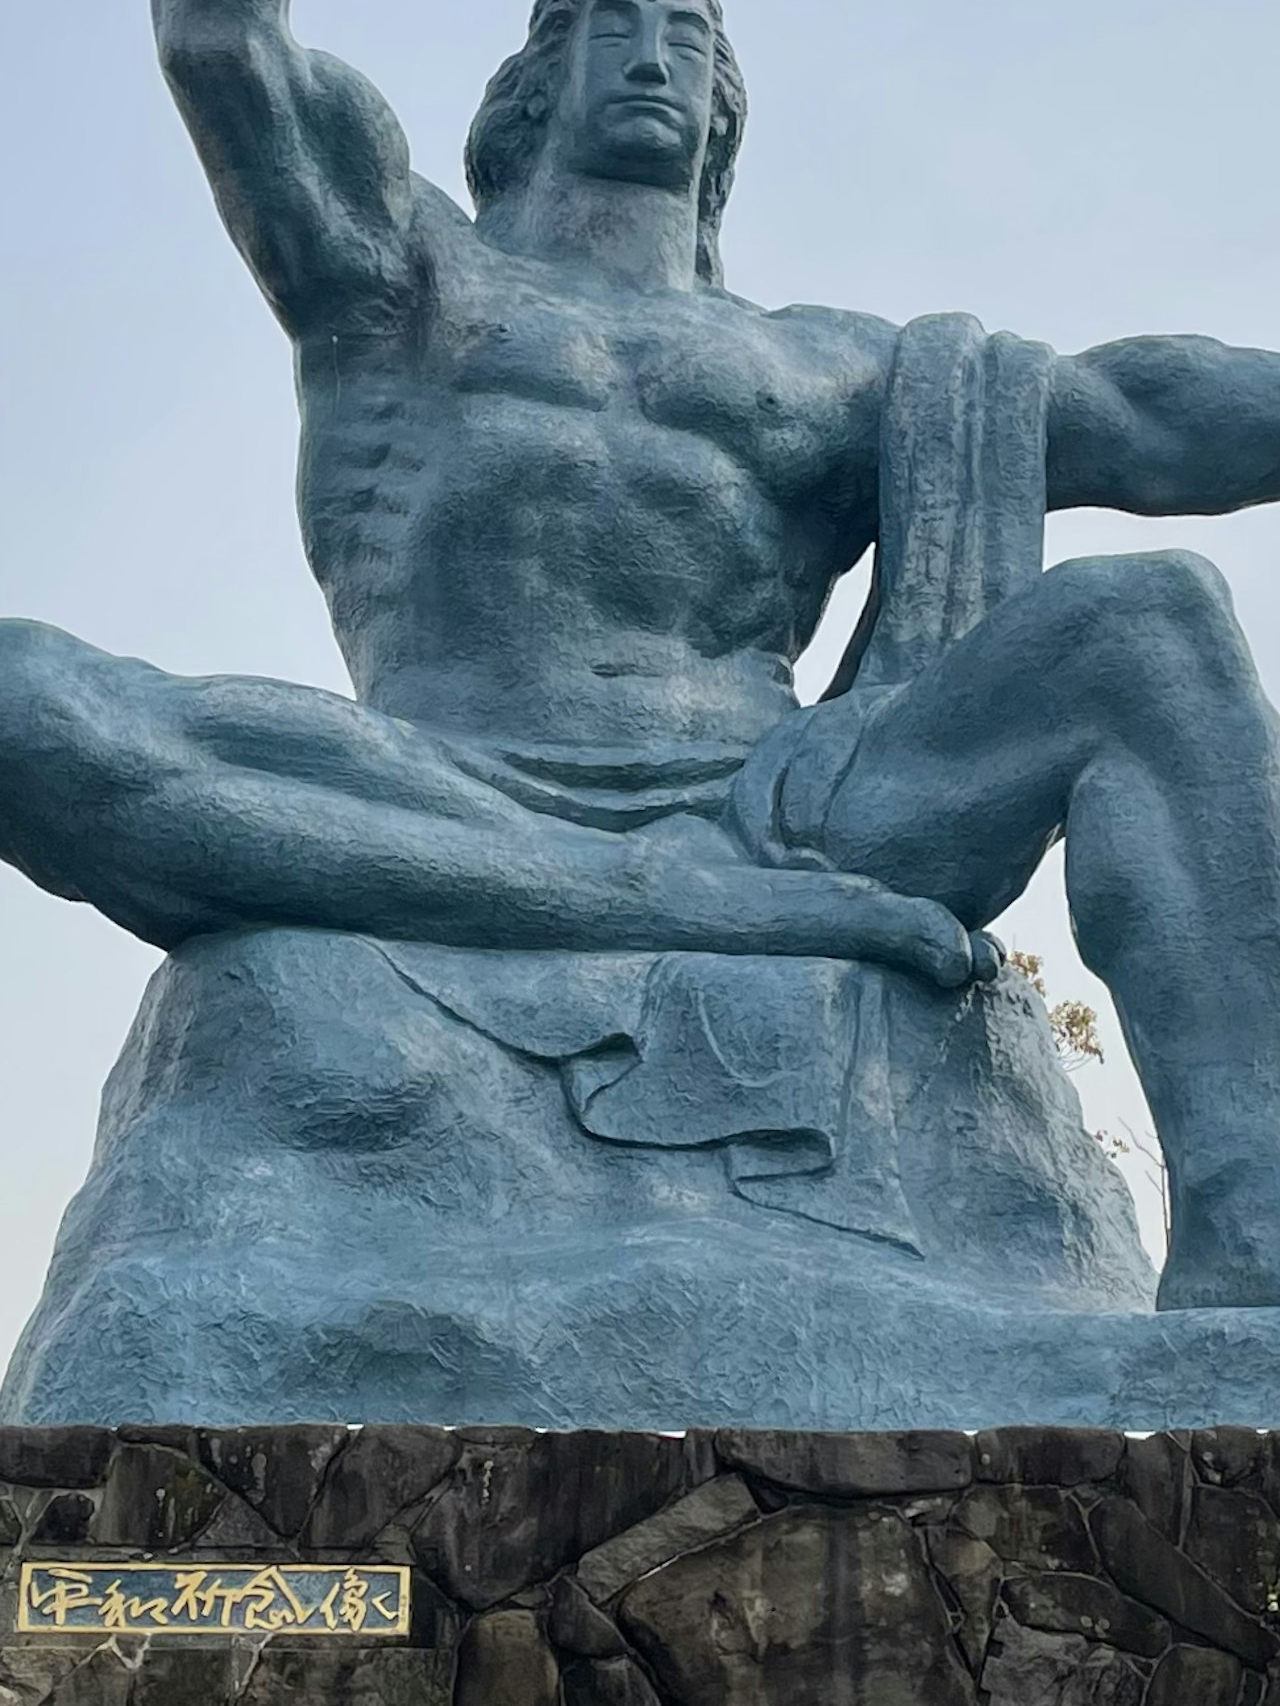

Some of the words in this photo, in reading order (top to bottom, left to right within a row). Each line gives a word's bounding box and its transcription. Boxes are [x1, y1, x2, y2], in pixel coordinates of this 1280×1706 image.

[30, 1566, 399, 1630] 平和祈念像
